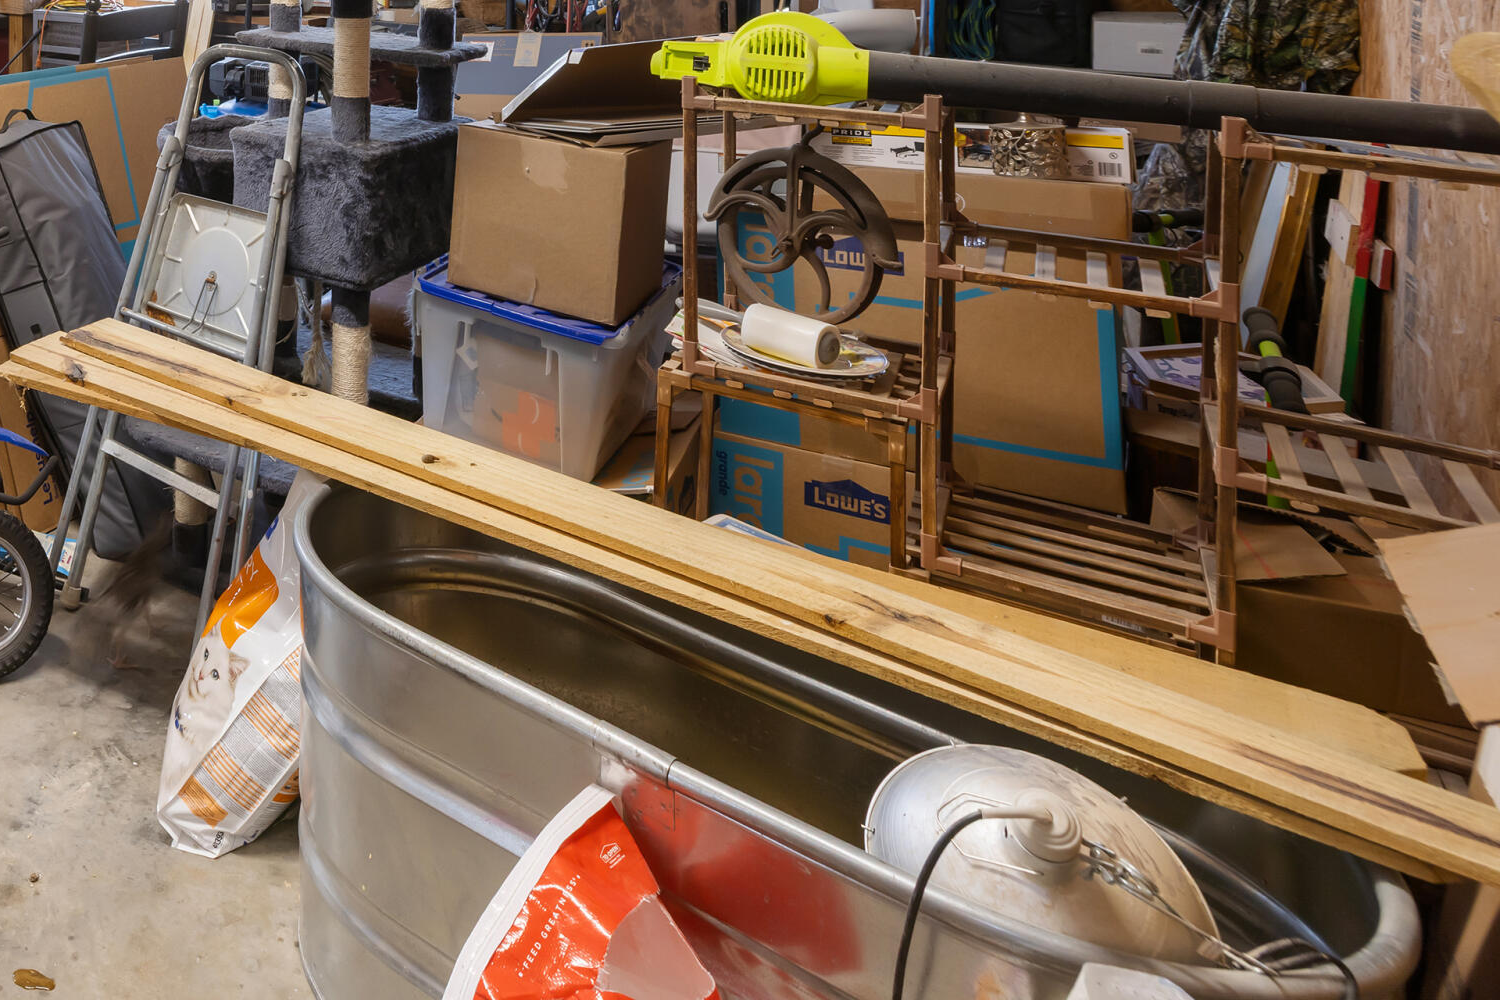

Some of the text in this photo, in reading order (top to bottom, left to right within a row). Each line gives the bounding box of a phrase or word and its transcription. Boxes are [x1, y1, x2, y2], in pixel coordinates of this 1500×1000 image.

[832, 128, 871, 137] PRIDE
[715, 450, 731, 496] grande
[813, 487, 887, 520] LOWE'S
[522, 941, 542, 970] FEED
